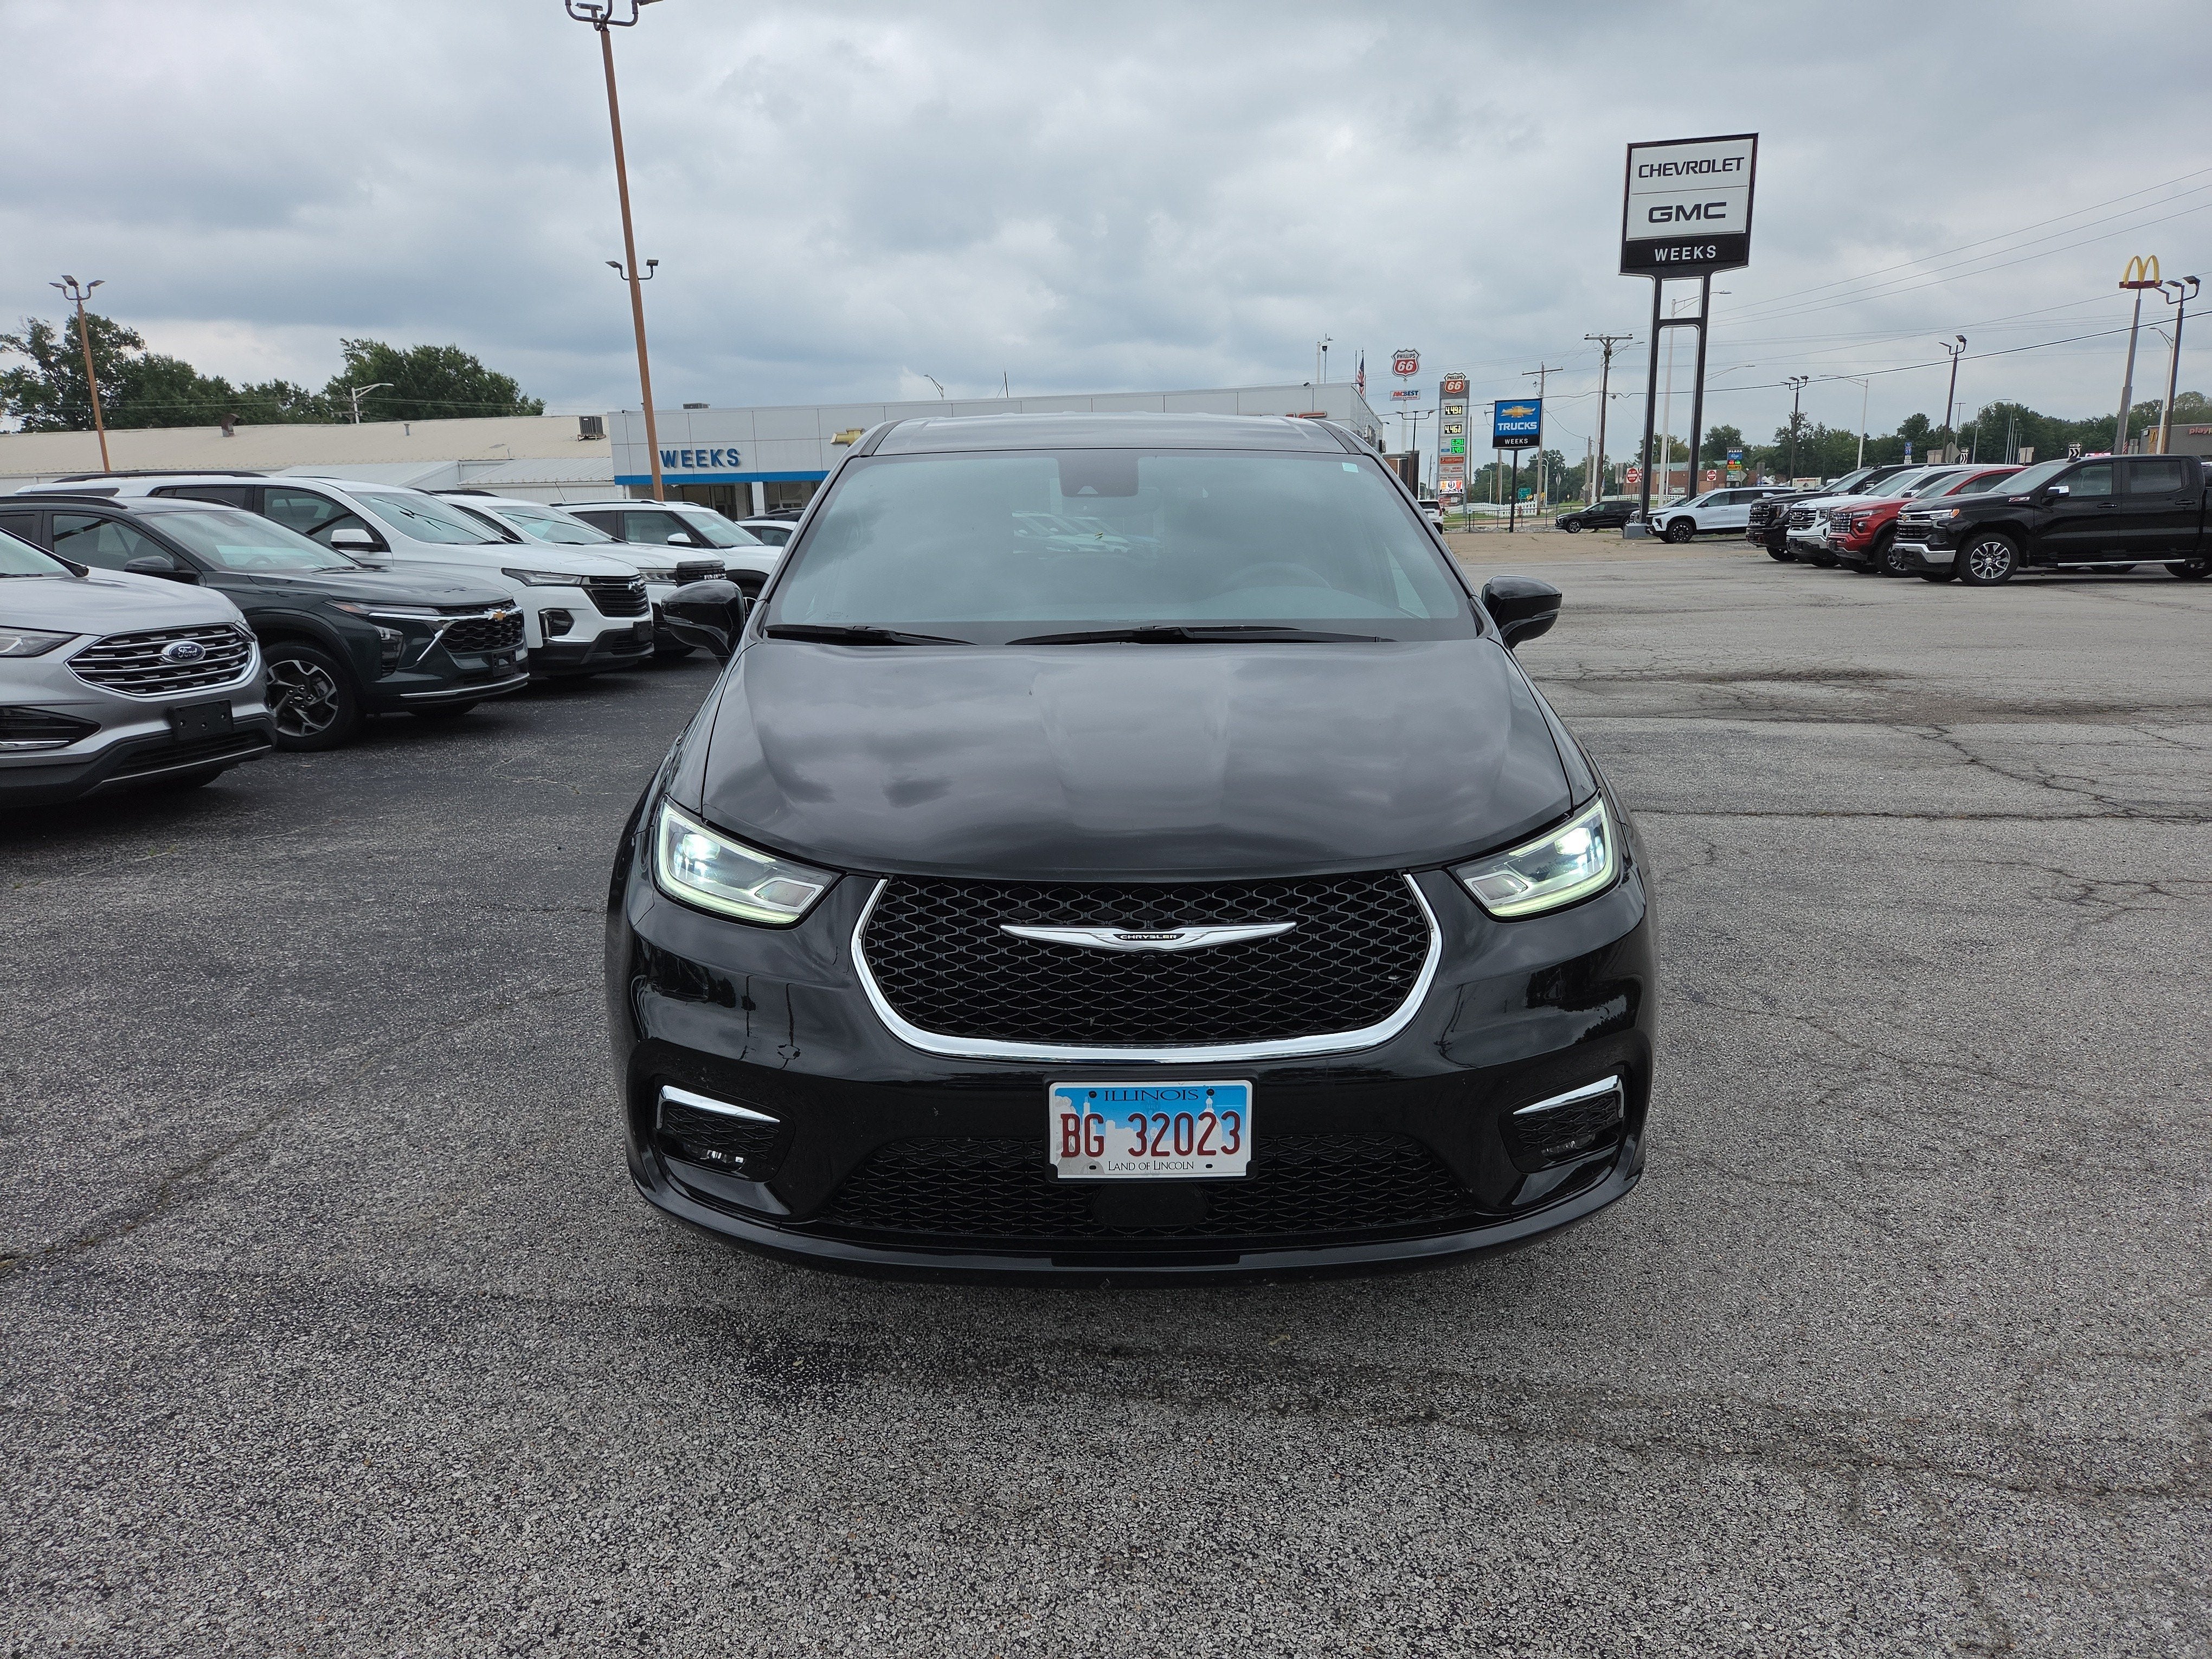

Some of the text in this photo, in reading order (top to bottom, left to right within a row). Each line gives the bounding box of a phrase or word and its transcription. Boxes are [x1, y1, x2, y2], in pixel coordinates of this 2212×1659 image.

[1638, 157, 1745, 178] CHEVROLET
[1648, 201, 1727, 223] GMC
[1654, 245, 1716, 262] WEEKS
[1397, 361, 1414, 371] 66
[1447, 381, 1462, 390] 66
[1497, 421, 1537, 431] TRUCKS
[660, 448, 741, 468] WEEKS
[178, 646, 197, 658] Ford
[1104, 1088, 1199, 1102] ILLINOIS
[1060, 1110, 1242, 1158] BG 32023
[1108, 1160, 1194, 1171] LAND OF LINCOLN
